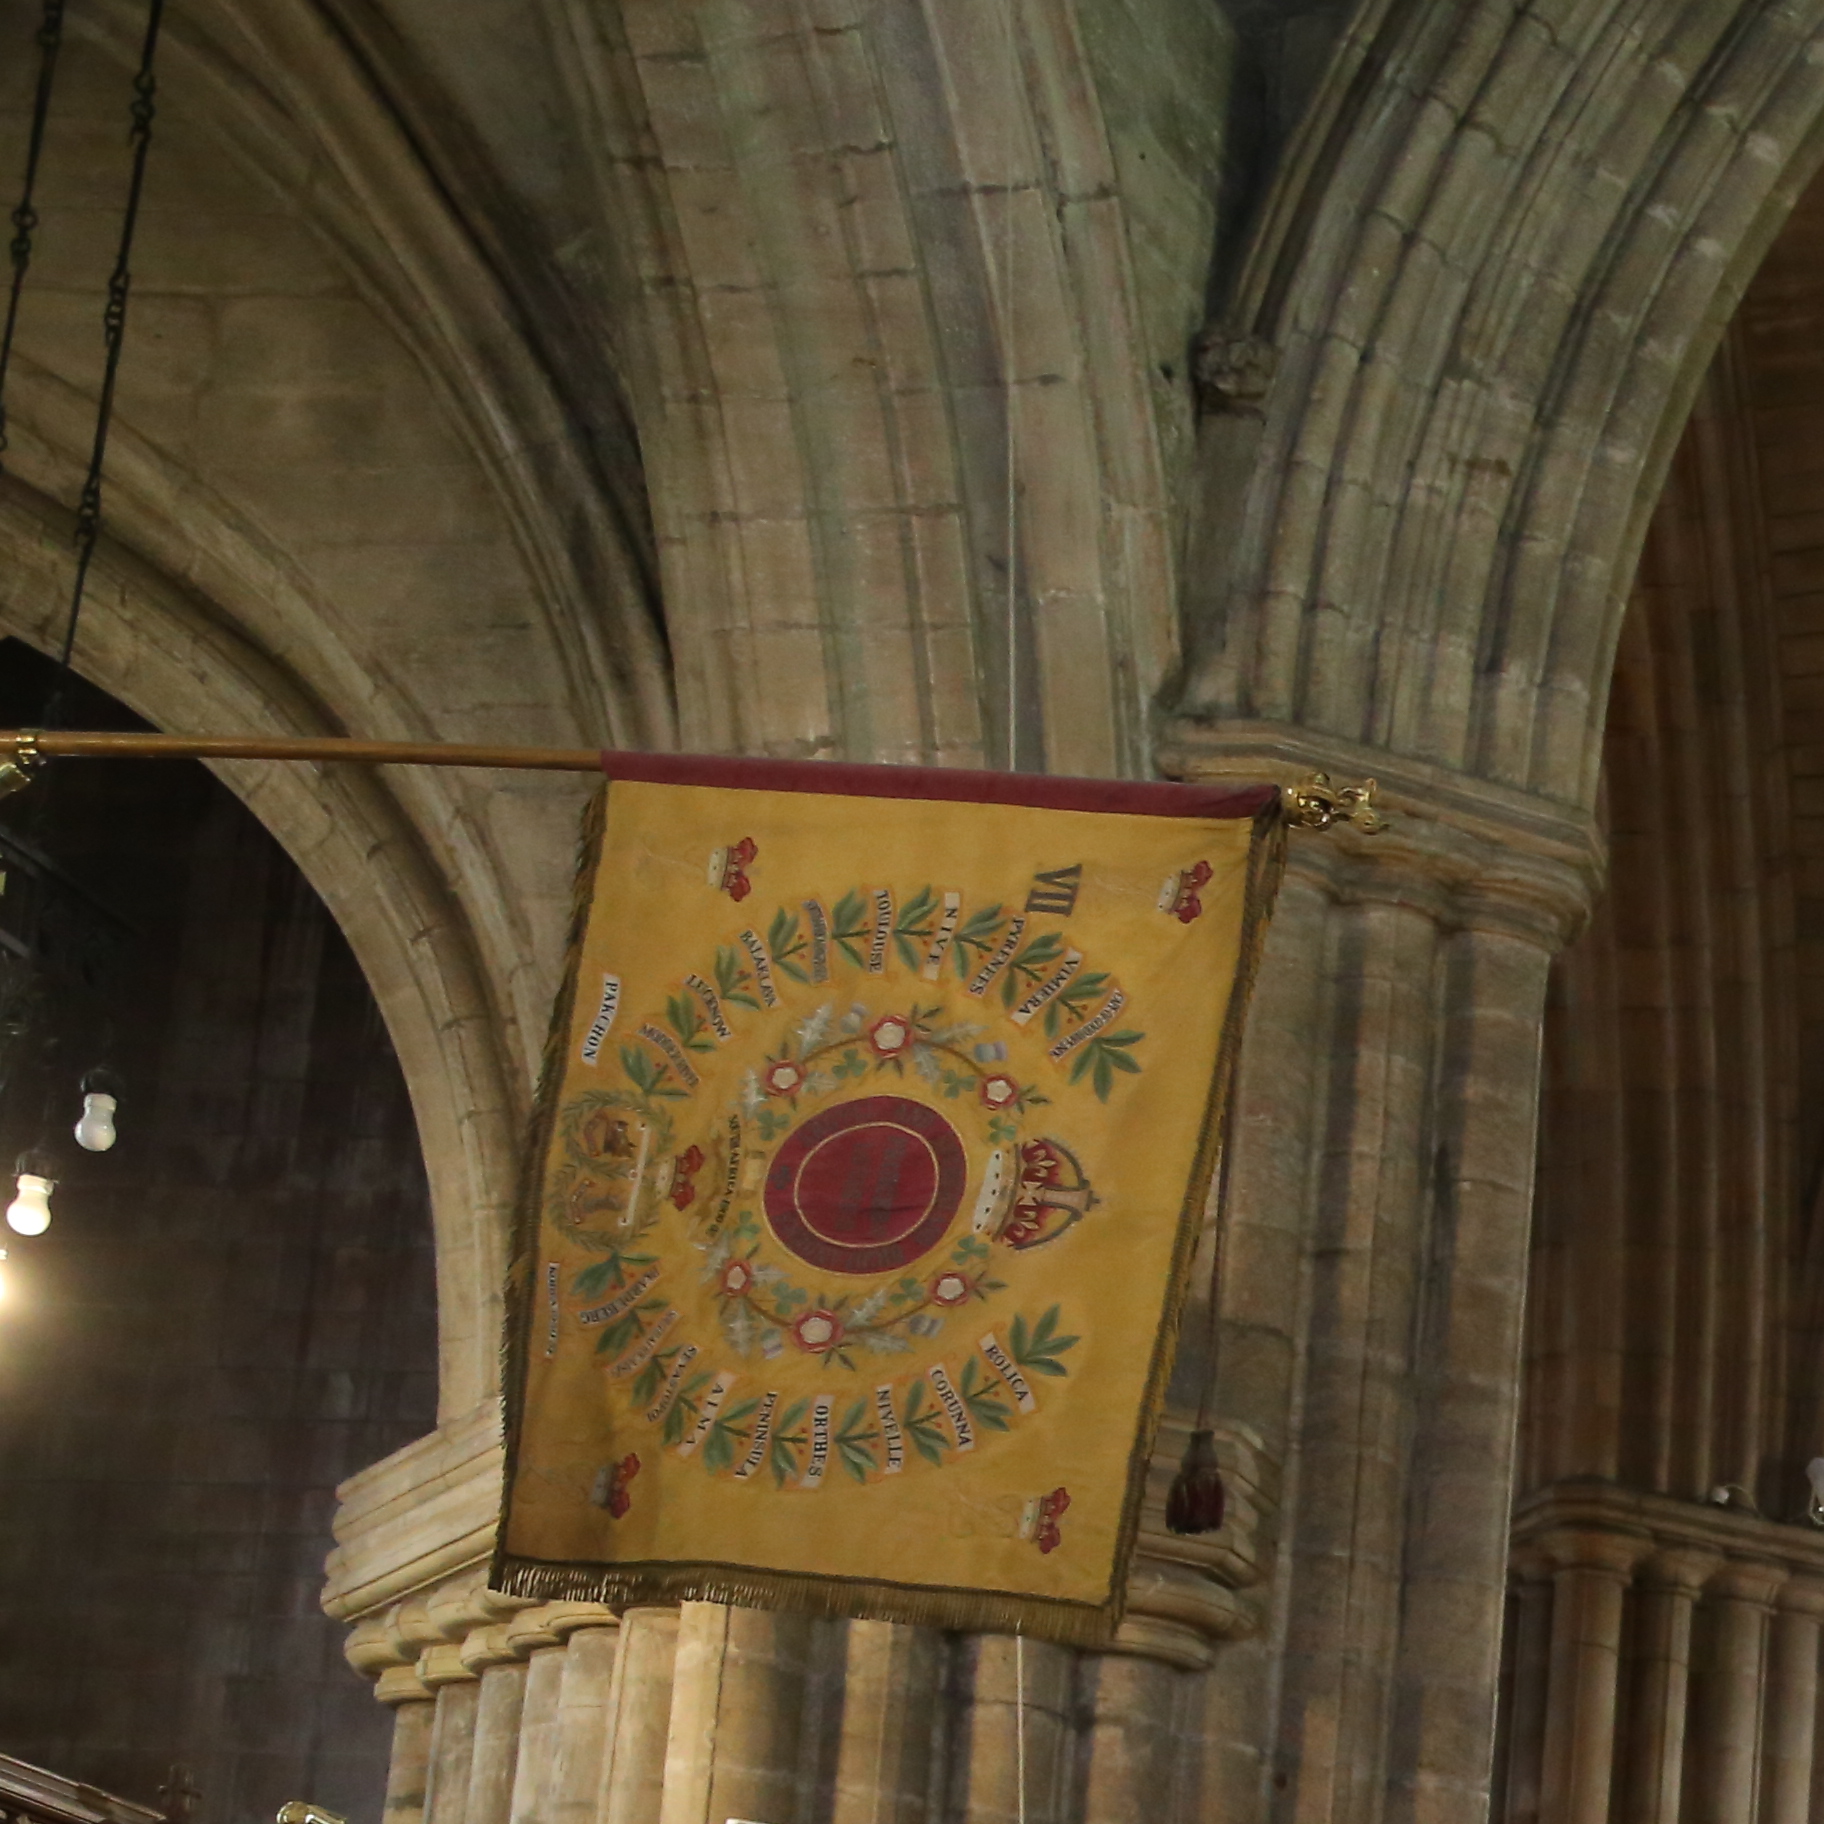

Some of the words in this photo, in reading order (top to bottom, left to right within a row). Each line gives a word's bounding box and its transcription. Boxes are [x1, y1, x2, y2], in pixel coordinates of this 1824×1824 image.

[1025, 864, 1082, 917] VII
[740, 930, 776, 1007] BALAKLAVA
[870, 891, 890, 973] TOULOUSE
[927, 908, 958, 966] NIVE
[969, 918, 1025, 995] PYRENEES
[584, 982, 618, 1060] PAKCHON
[686, 974, 730, 1038] LUCKNOW
[1018, 959, 1078, 1015] VIMIERA
[932, 1370, 972, 1446] CORUNNA
[985, 1345, 1028, 1401] ROLICA
[686, 1383, 724, 1446] ALMA
[735, 1393, 776, 1478] PENINSULA
[808, 1405, 829, 1477] ORTHES
[877, 1390, 901, 1468] NIVELLE
